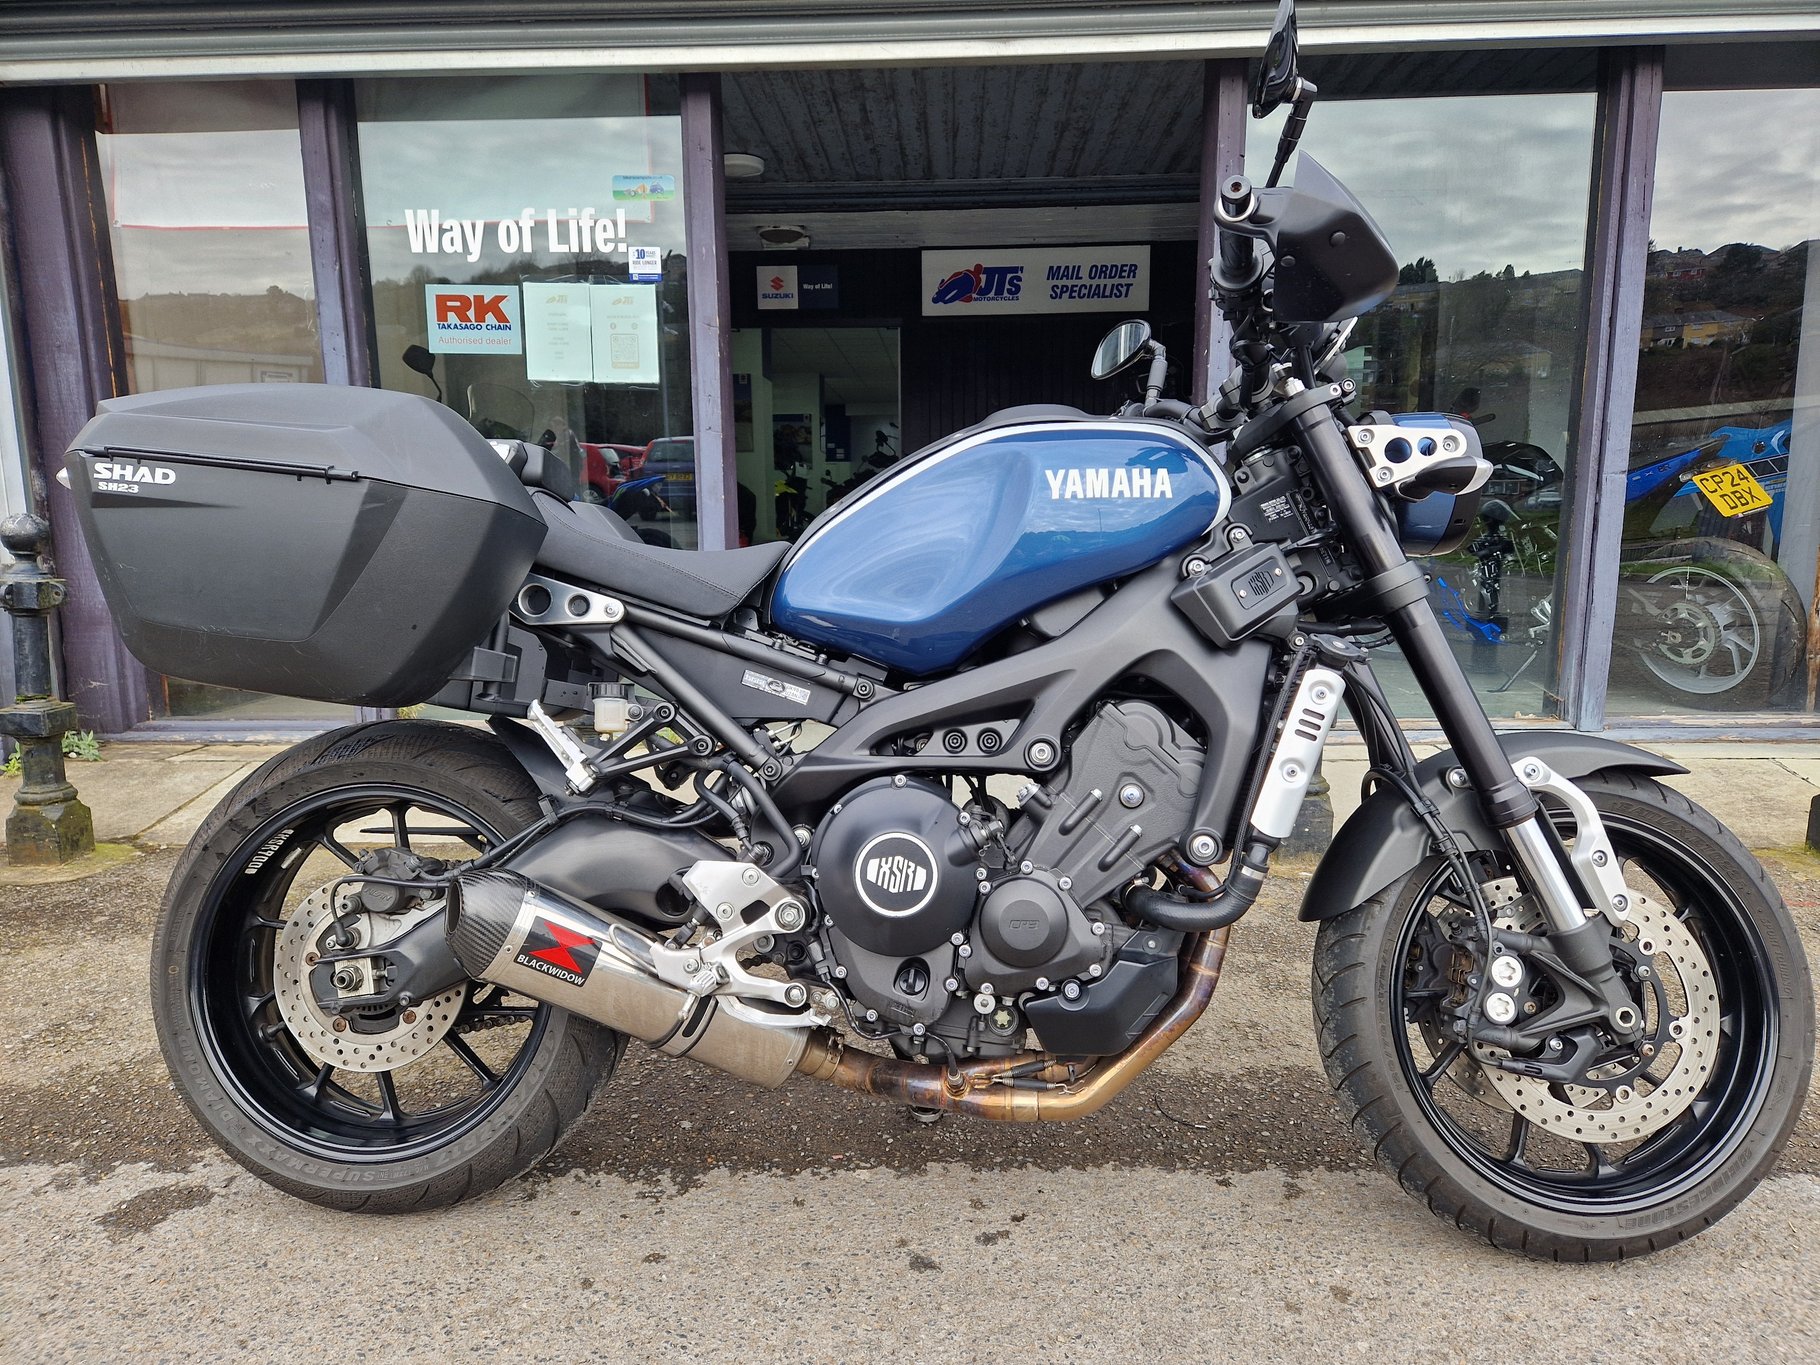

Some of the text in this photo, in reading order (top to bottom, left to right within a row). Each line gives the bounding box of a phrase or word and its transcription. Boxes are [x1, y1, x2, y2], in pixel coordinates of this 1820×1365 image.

[405, 207, 628, 262] Way of Life!
[635, 248, 646, 260] 10
[1046, 263, 1138, 281] MAIL ORDER
[1049, 283, 1134, 300] SPECIALIST
[434, 294, 511, 323] RK
[437, 323, 512, 331] TAKASAGO CHAIN
[438, 335, 512, 345] Authorised dealer
[93, 462, 176, 485] SHAD
[1045, 468, 1173, 499] YAMAHA
[1699, 468, 1750, 494] CP24
[97, 481, 140, 494] SH23
[1719, 487, 1761, 510] DBX
[516, 954, 585, 985] BLACKWIDOW
[177, 1035, 376, 1182] SUPERMAXX DIAMOND
